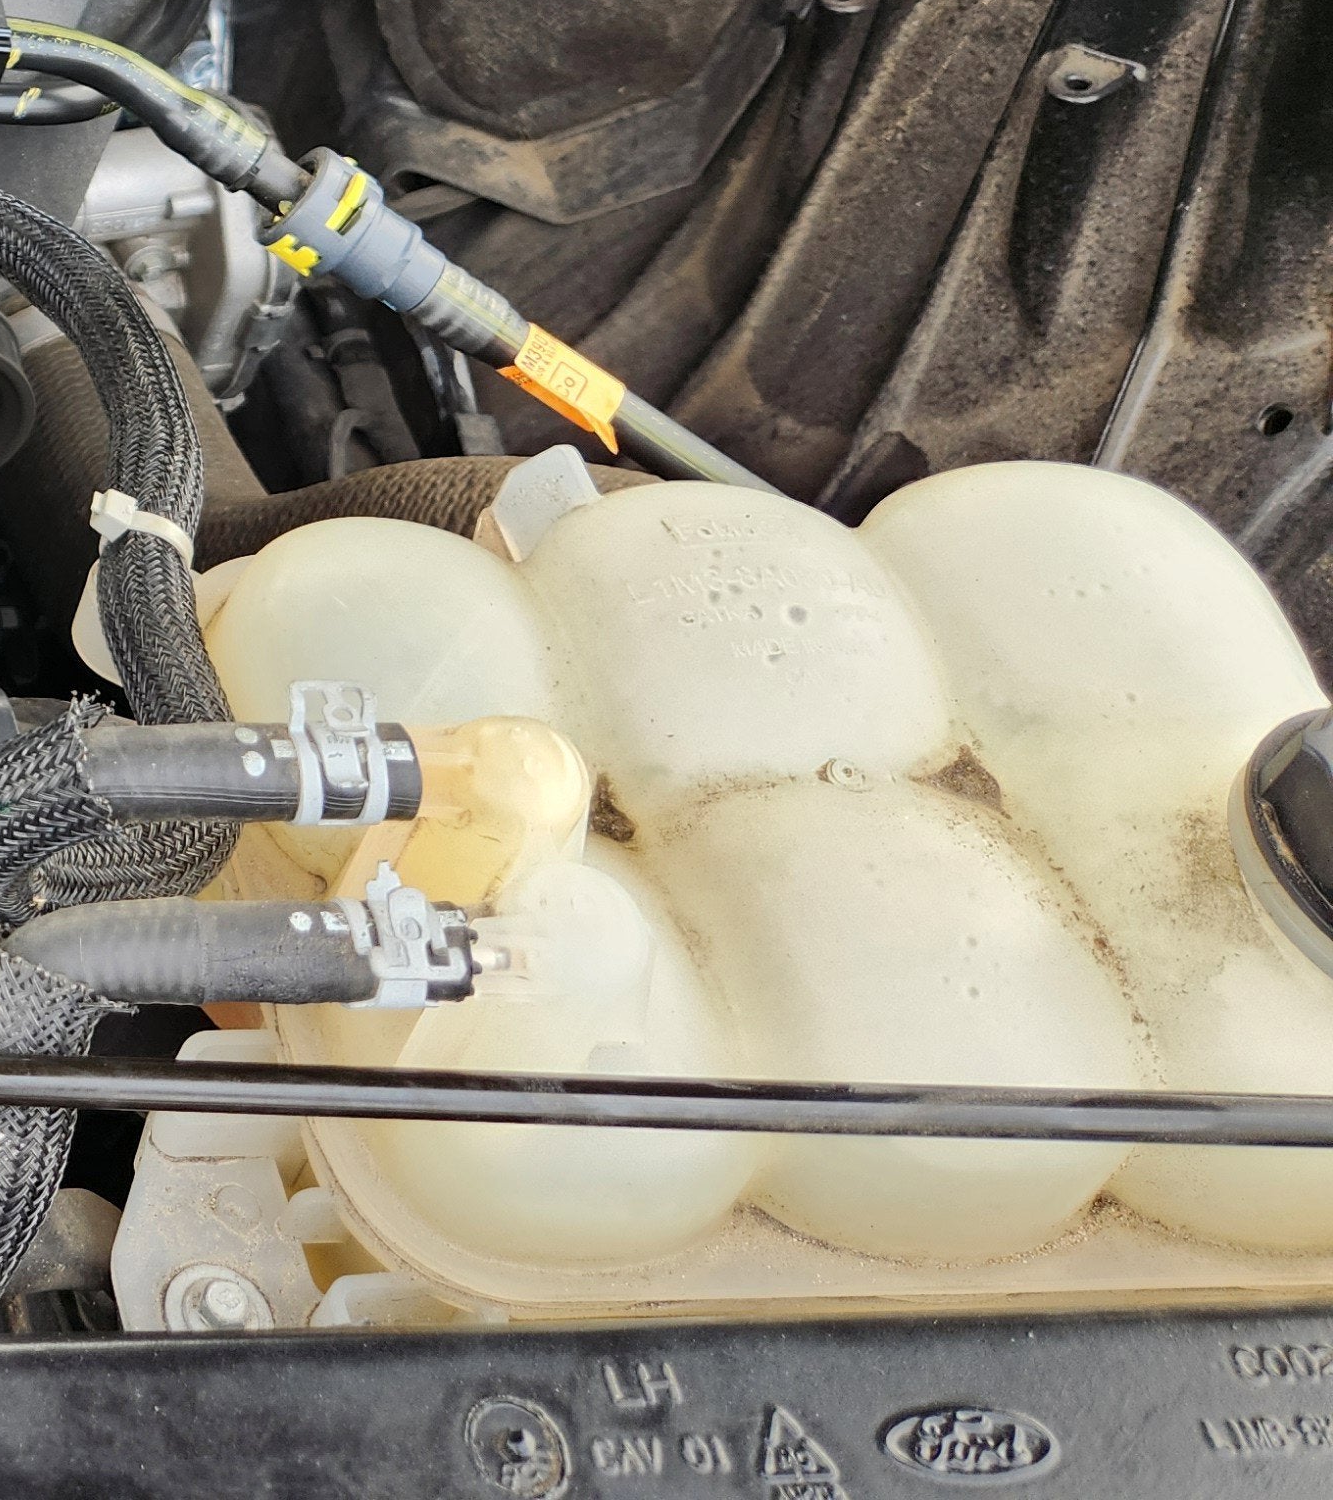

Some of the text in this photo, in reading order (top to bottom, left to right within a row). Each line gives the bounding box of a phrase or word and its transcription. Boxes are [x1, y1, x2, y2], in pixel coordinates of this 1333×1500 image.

[604, 1361, 684, 1408] LH
[591, 1433, 664, 1477] CAV
[916, 1409, 1031, 1473] Ford
